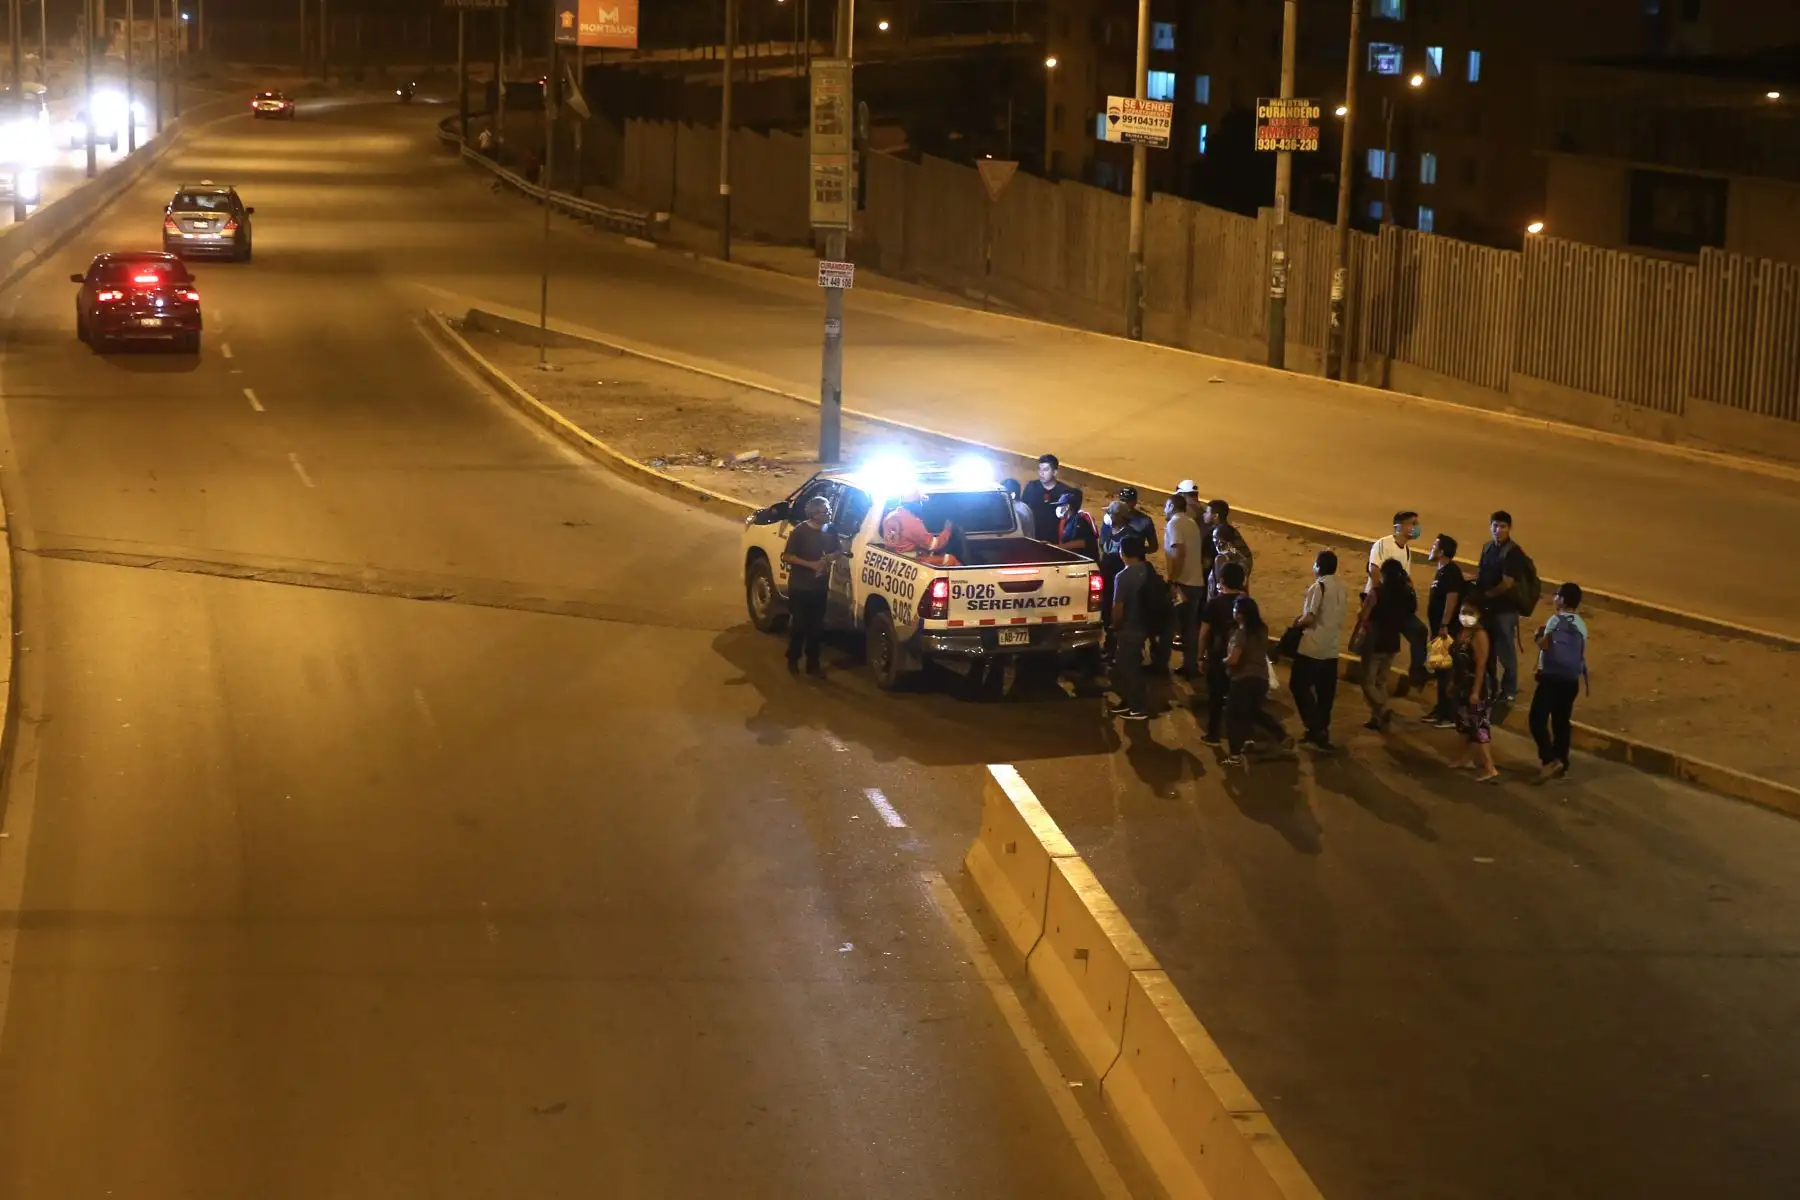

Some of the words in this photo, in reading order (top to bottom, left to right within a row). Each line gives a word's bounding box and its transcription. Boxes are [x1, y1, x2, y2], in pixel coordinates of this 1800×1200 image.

[580, 23, 636, 35] MONTALVO
[1123, 99, 1137, 109] SE
[1139, 100, 1171, 113] VENDE
[1258, 106, 1320, 118] CURANDERO
[1122, 115, 1170, 128] 991043178
[864, 550, 918, 581] SERENAZGO
[966, 595, 1072, 612] SERENAZGO
